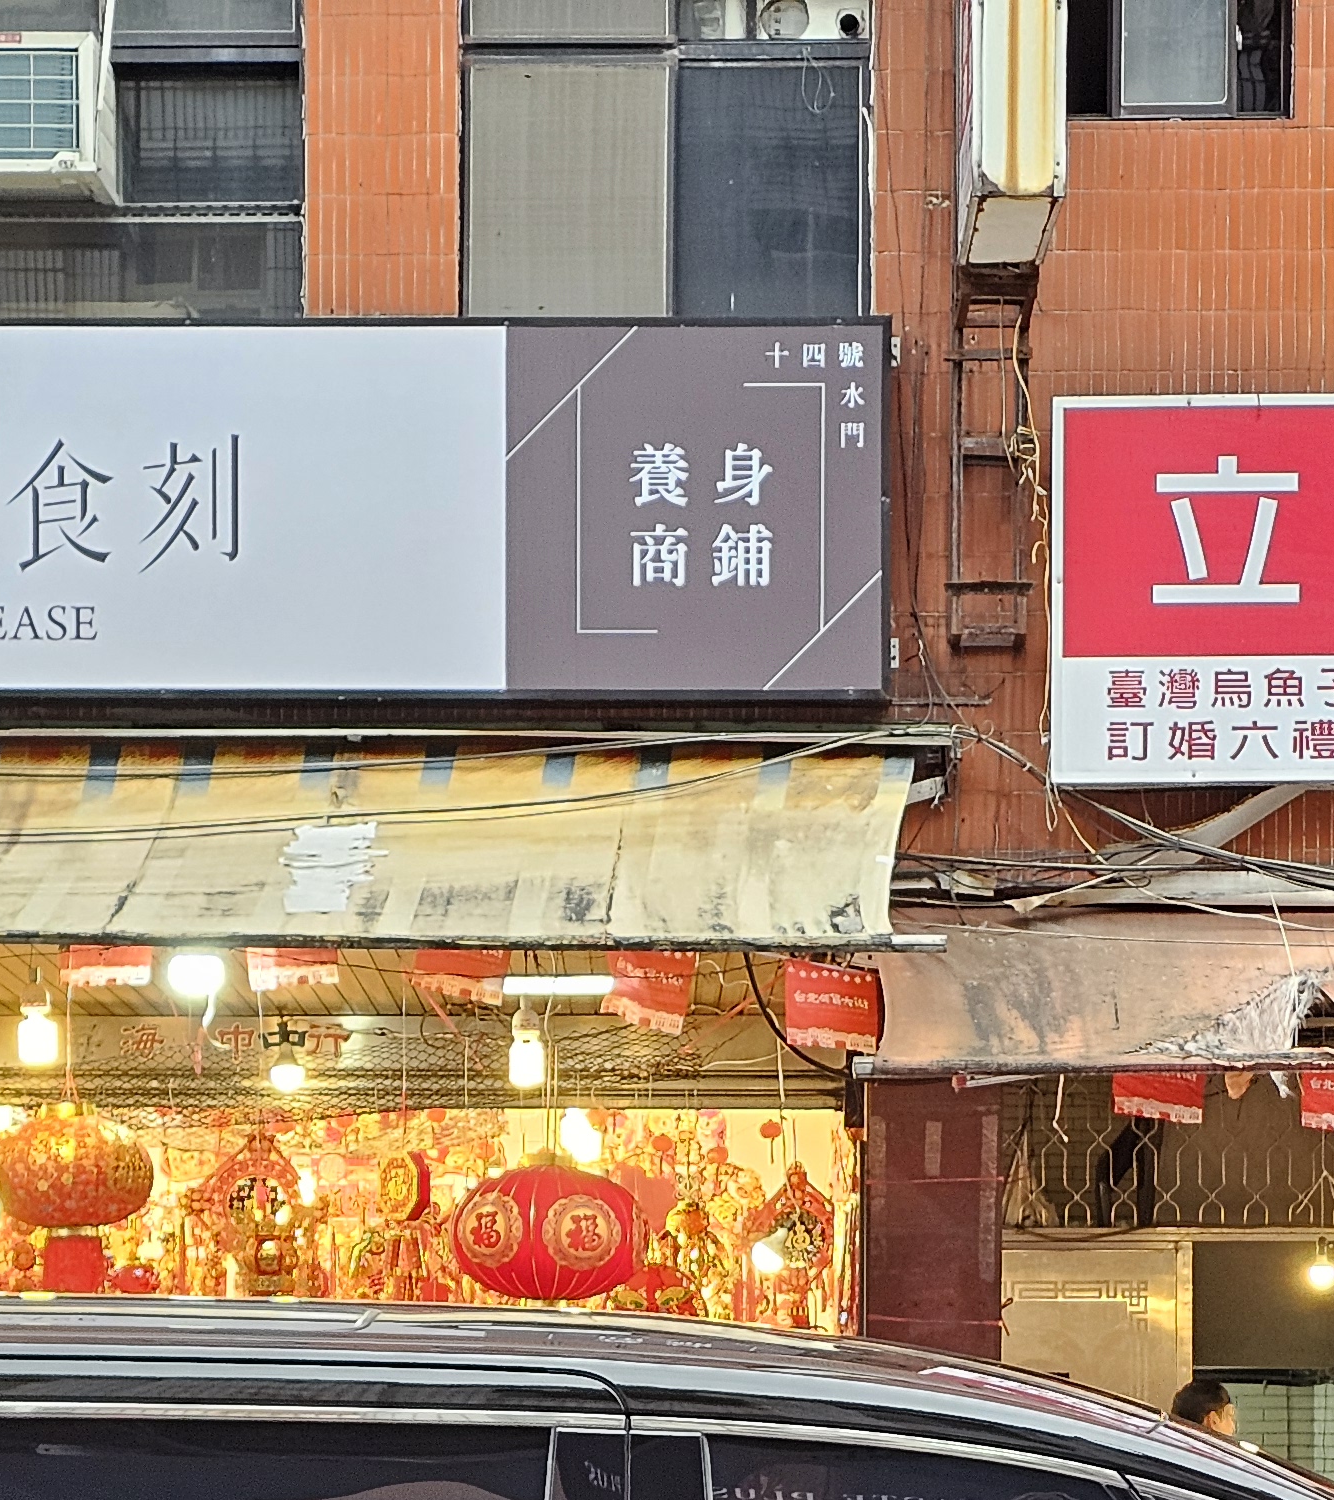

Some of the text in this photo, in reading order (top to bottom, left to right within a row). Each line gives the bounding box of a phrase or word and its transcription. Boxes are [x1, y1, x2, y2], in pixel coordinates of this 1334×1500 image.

[765, 341, 865, 449] 十四號 水門
[5, 433, 240, 575] 食刻
[629, 442, 774, 507] 養身
[629, 523, 774, 587] 商鋪
[469, 1210, 605, 1252] 福 福
